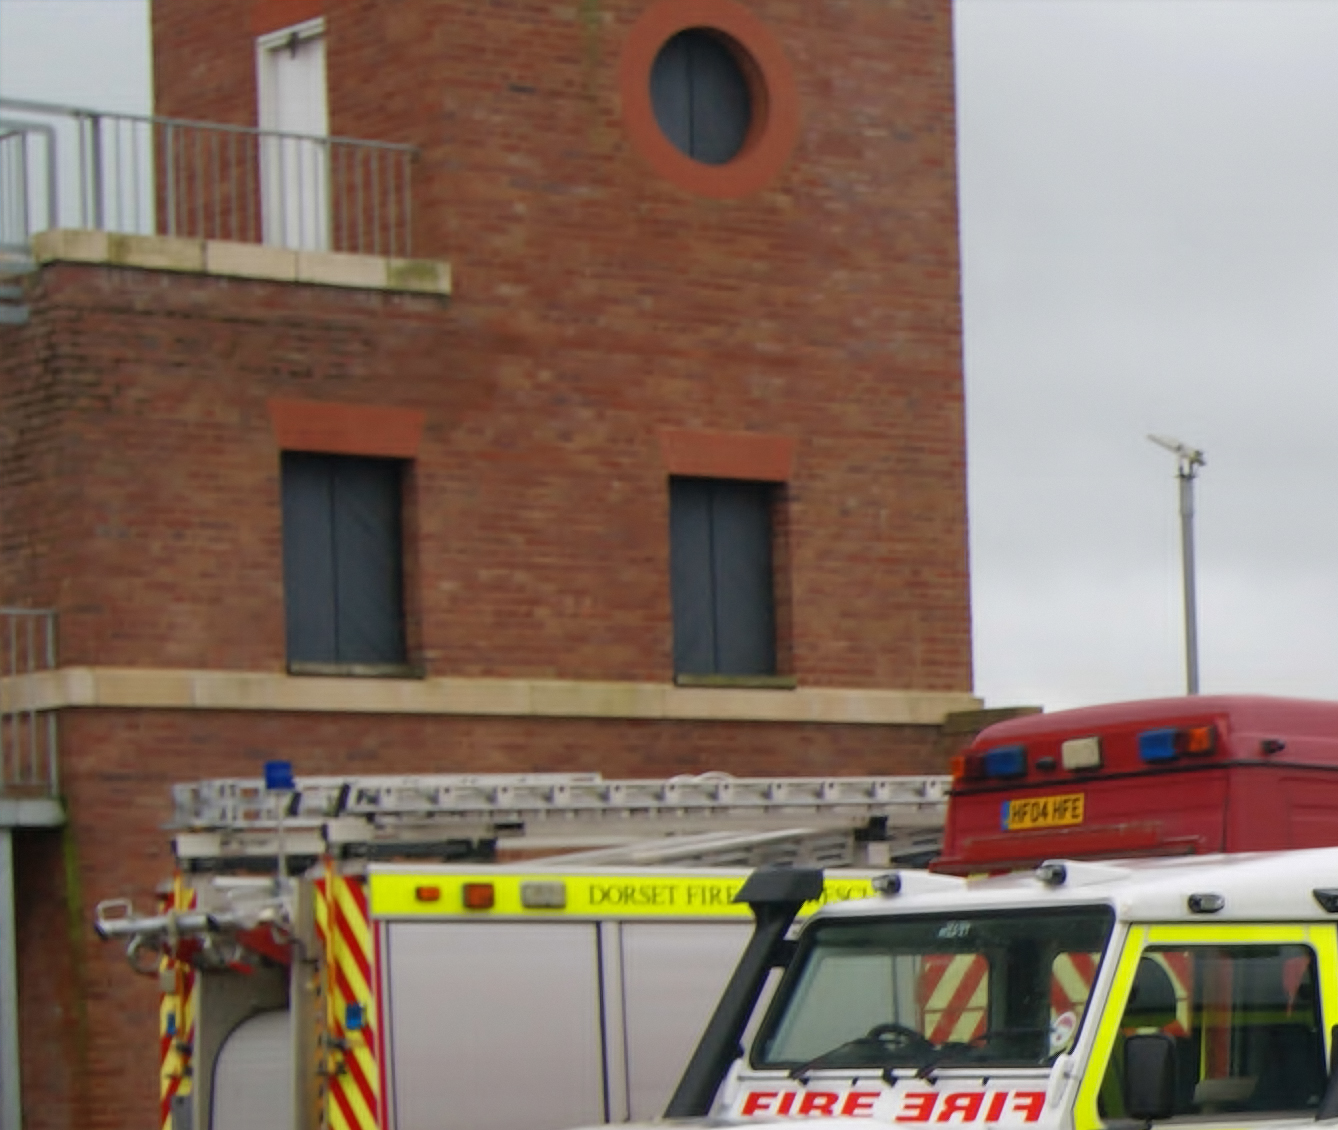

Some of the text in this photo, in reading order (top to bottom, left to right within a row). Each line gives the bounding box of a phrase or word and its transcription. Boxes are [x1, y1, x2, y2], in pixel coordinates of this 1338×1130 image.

[1012, 797, 1081, 823] HF04 HFE
[588, 884, 676, 905] DORSET
[741, 1091, 881, 1117] FIRE
